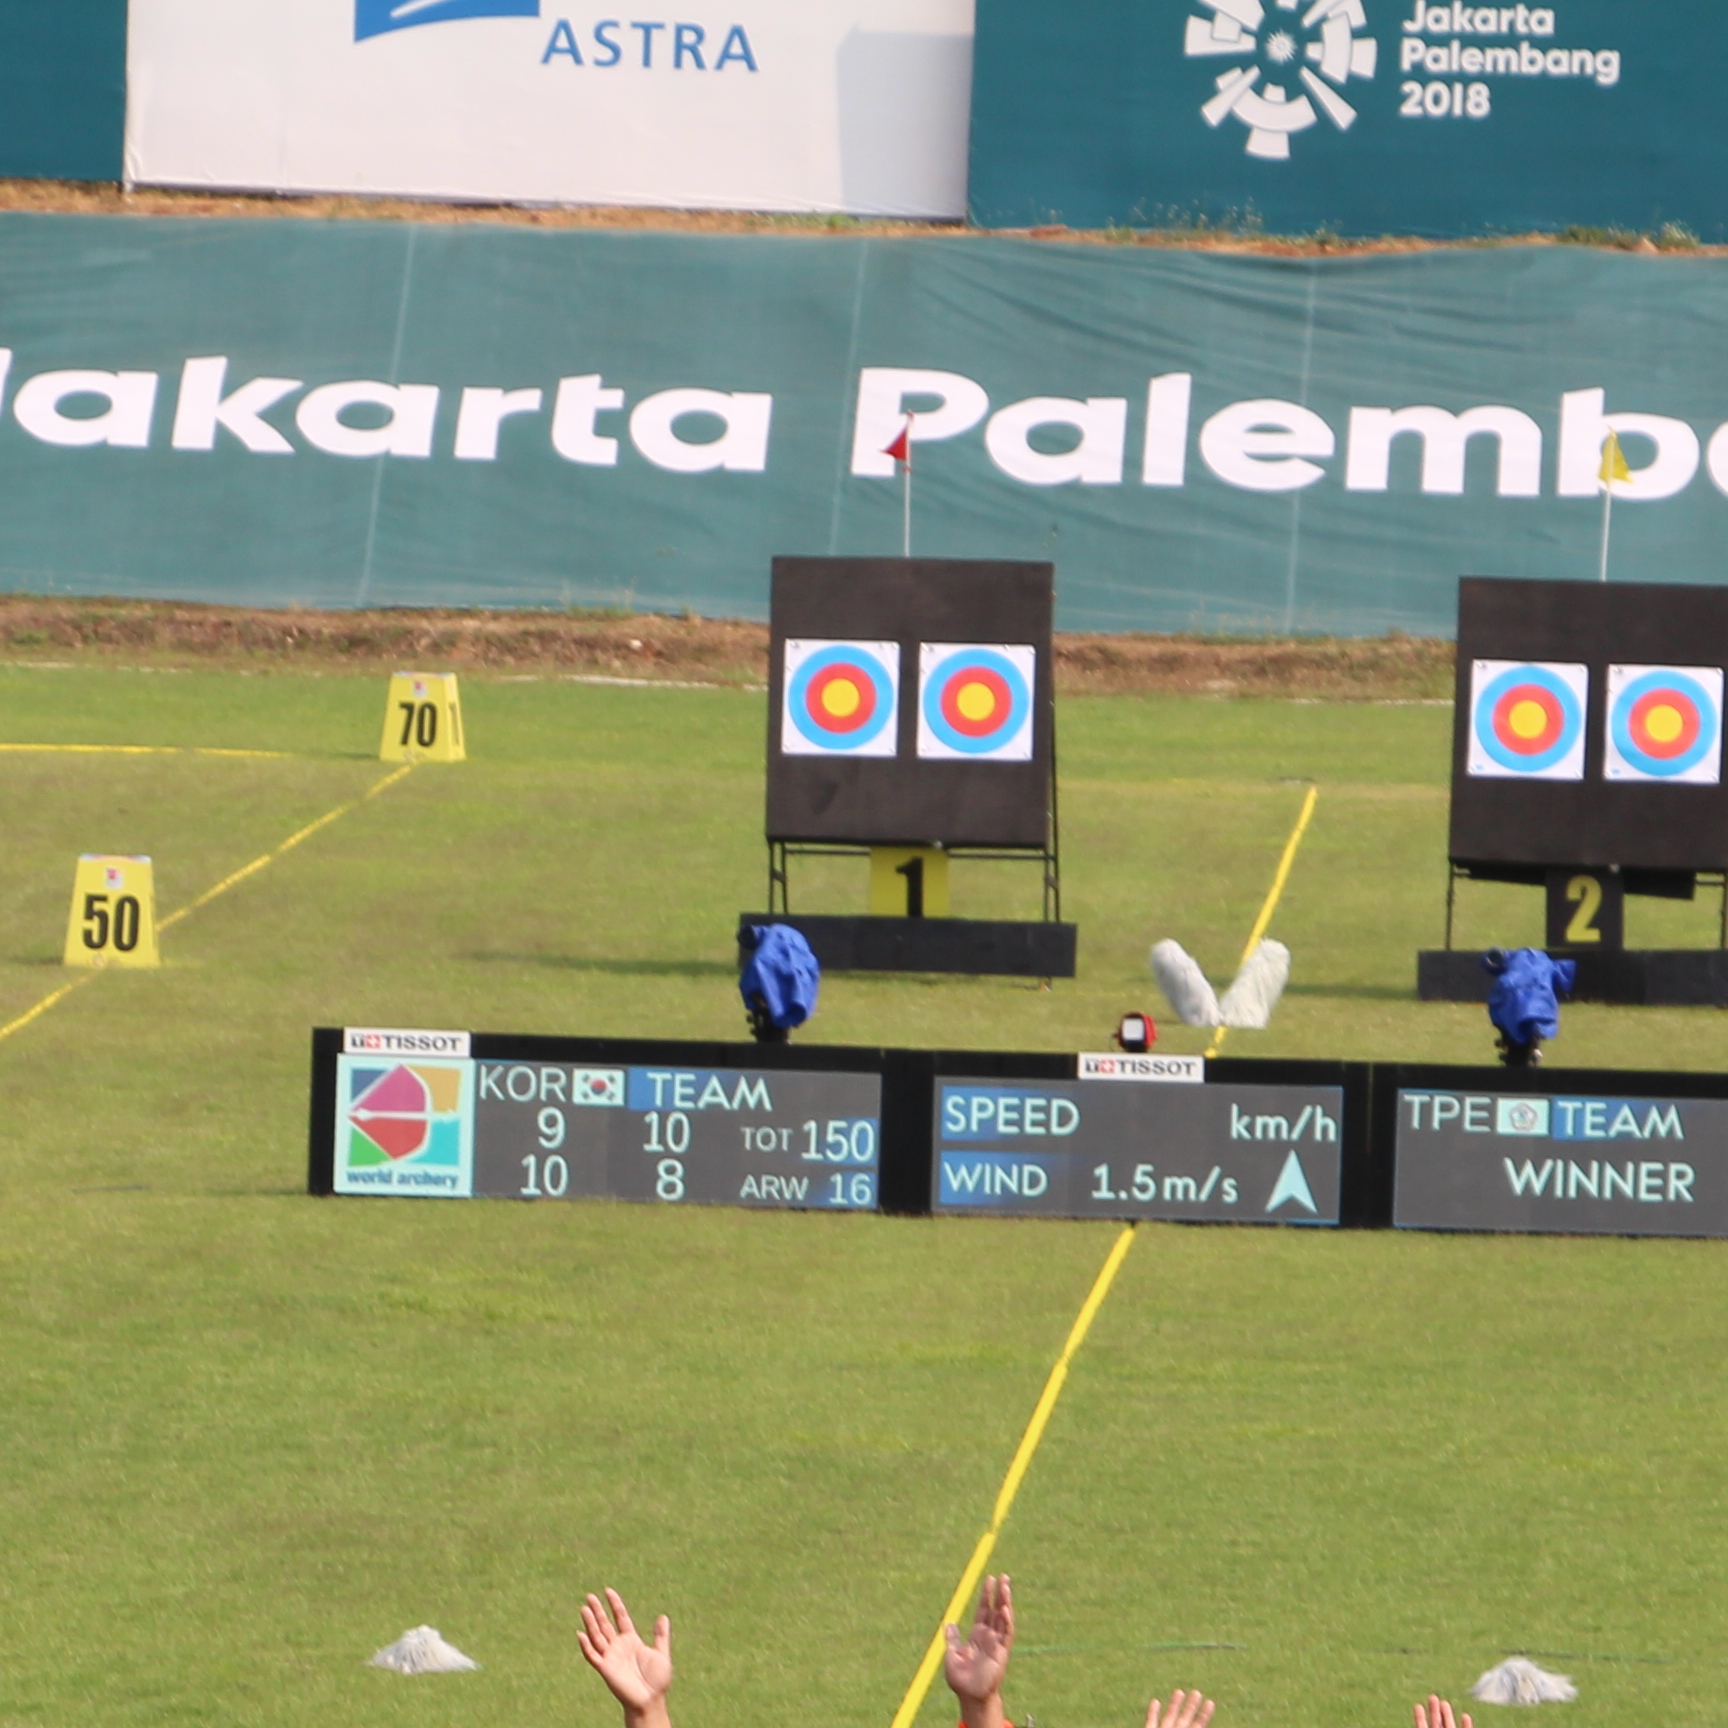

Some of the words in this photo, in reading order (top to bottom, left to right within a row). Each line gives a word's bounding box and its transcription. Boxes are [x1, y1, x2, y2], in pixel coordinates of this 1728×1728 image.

[1402, 0, 1555, 36] Jakarta
[540, 20, 760, 74] ASTRA
[1400, 41, 1620, 85] Palembang
[1399, 82, 1491, 117] 2018
[399, 701, 437, 748] 70
[894, 855, 926, 918] 1
[1564, 874, 1603, 943] 2
[82, 894, 140, 952] 50
[381, 1034, 461, 1052] TISSOT
[480, 1064, 568, 1102] KOR
[647, 1072, 772, 1112] TEAM
[1116, 1060, 1197, 1077] TISSOT
[537, 1106, 566, 1150] 9
[643, 1112, 690, 1154] 10
[741, 1126, 791, 1153] TOT
[801, 1121, 874, 1163] 150
[945, 1095, 1080, 1136] SPEED
[1230, 1103, 1337, 1142] km/h
[1404, 1094, 1491, 1133] TPE
[1558, 1102, 1684, 1140] TEAM
[347, 1168, 393, 1183] world
[397, 1169, 457, 1190] archery
[521, 1154, 568, 1197] 10
[656, 1160, 685, 1201] 8
[740, 1175, 807, 1201] ARW
[829, 1171, 871, 1203] 16
[943, 1160, 1048, 1197] WIND
[1504, 1157, 1695, 1203] WINNER
